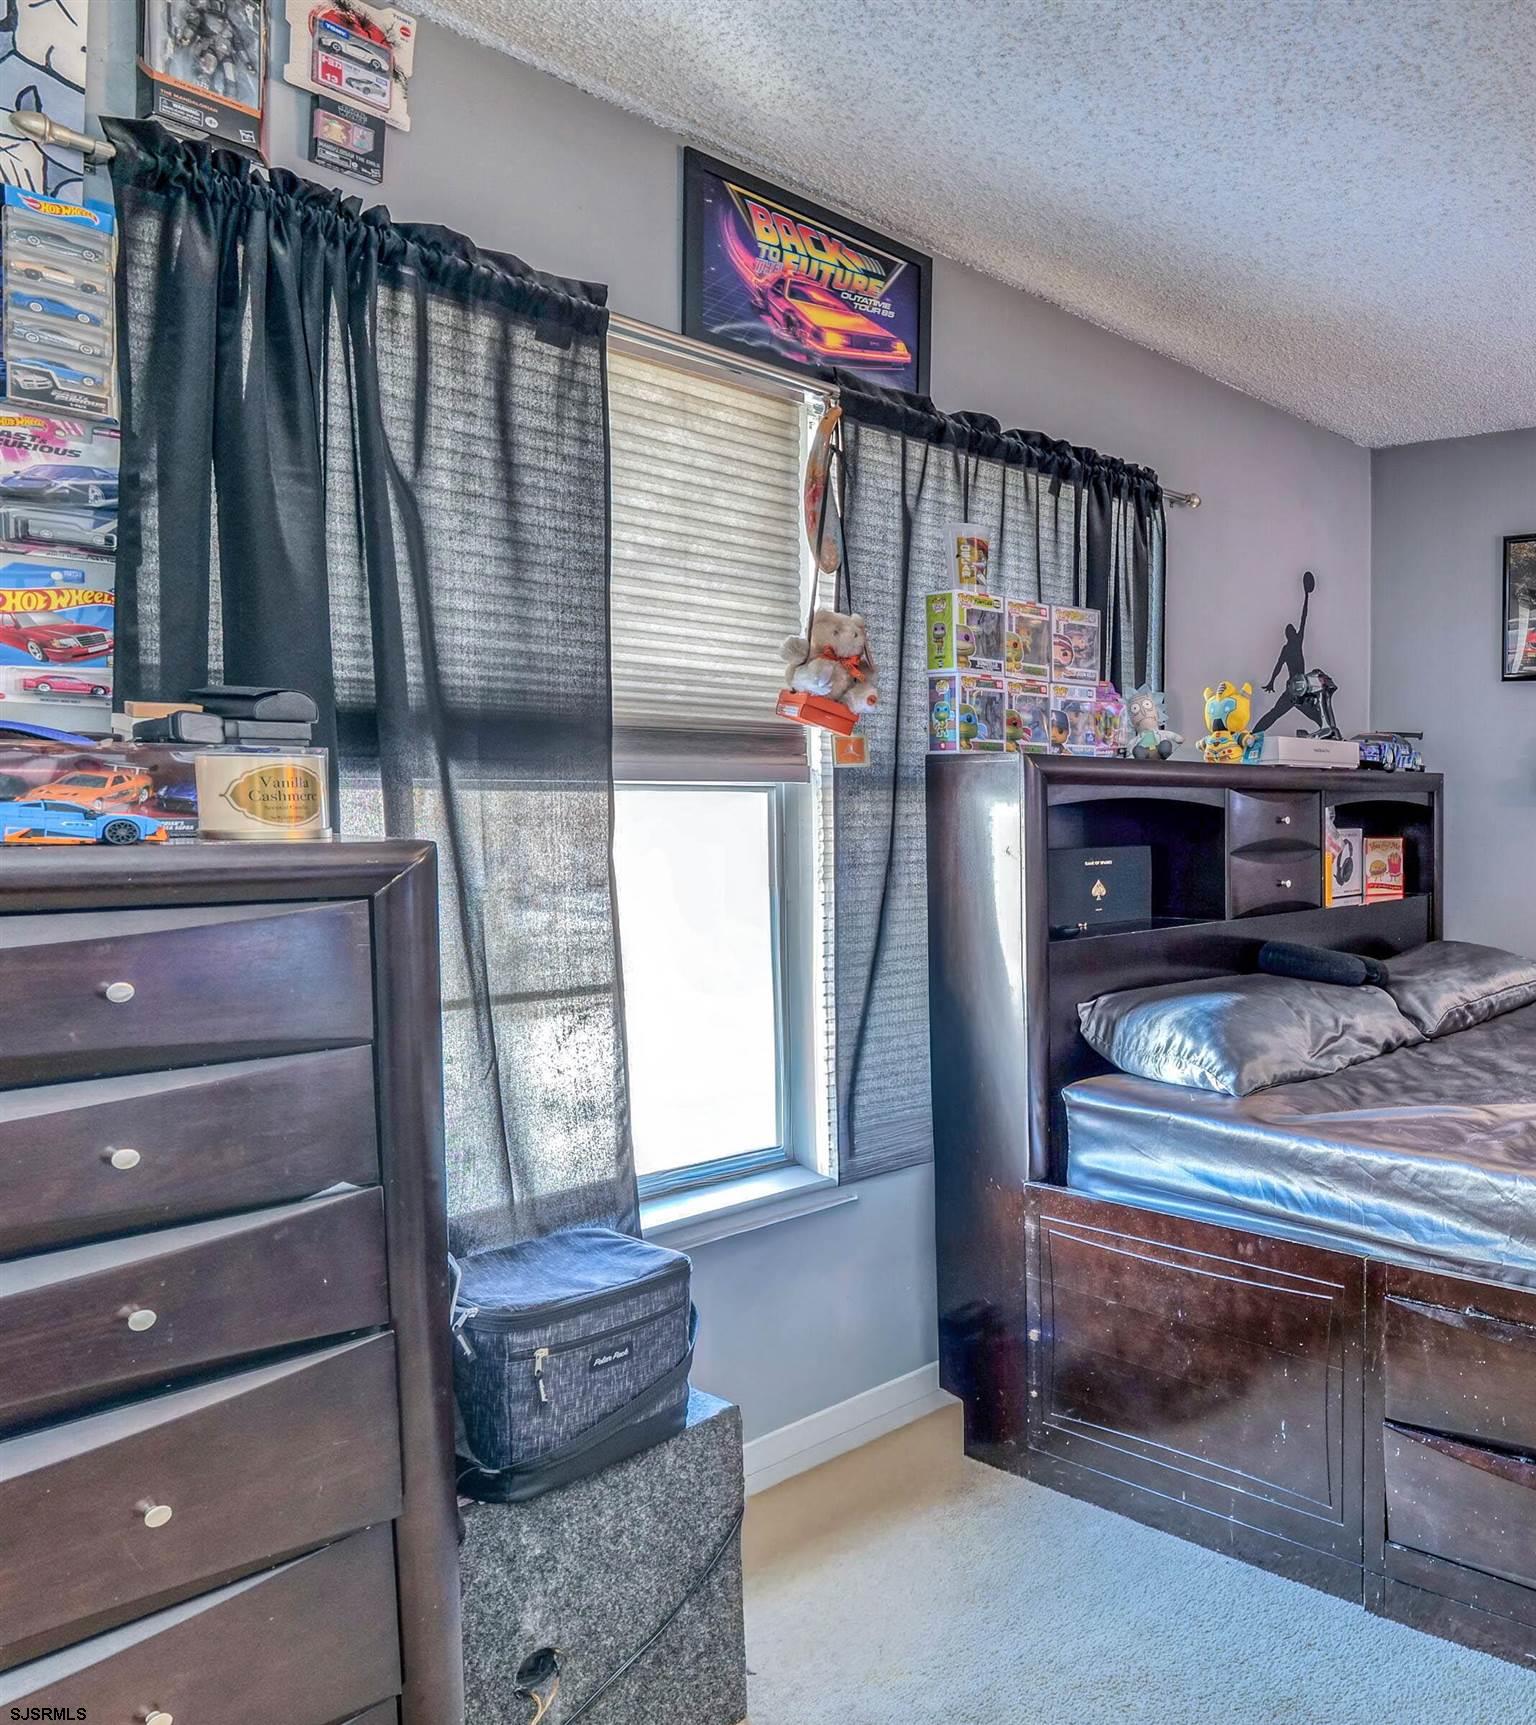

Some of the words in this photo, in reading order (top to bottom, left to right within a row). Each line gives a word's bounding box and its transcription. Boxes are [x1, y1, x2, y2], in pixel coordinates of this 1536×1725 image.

[325, 73, 338, 84] 13
[40, 202, 60, 215] HOT
[748, 202, 864, 274] BACK
[757, 243, 781, 262] TO
[783, 252, 886, 299] FUTURE
[841, 291, 892, 310] OUTATIME
[853, 303, 881, 316] TOUR
[881, 310, 895, 318] 85
[0, 430, 41, 444] AST
[0, 438, 82, 458] URIOUS
[2, 590, 50, 612] HOT
[48, 588, 115, 611] WHEEL
[260, 776, 309, 789] Vanilla
[248, 790, 318, 802] Cashmere
